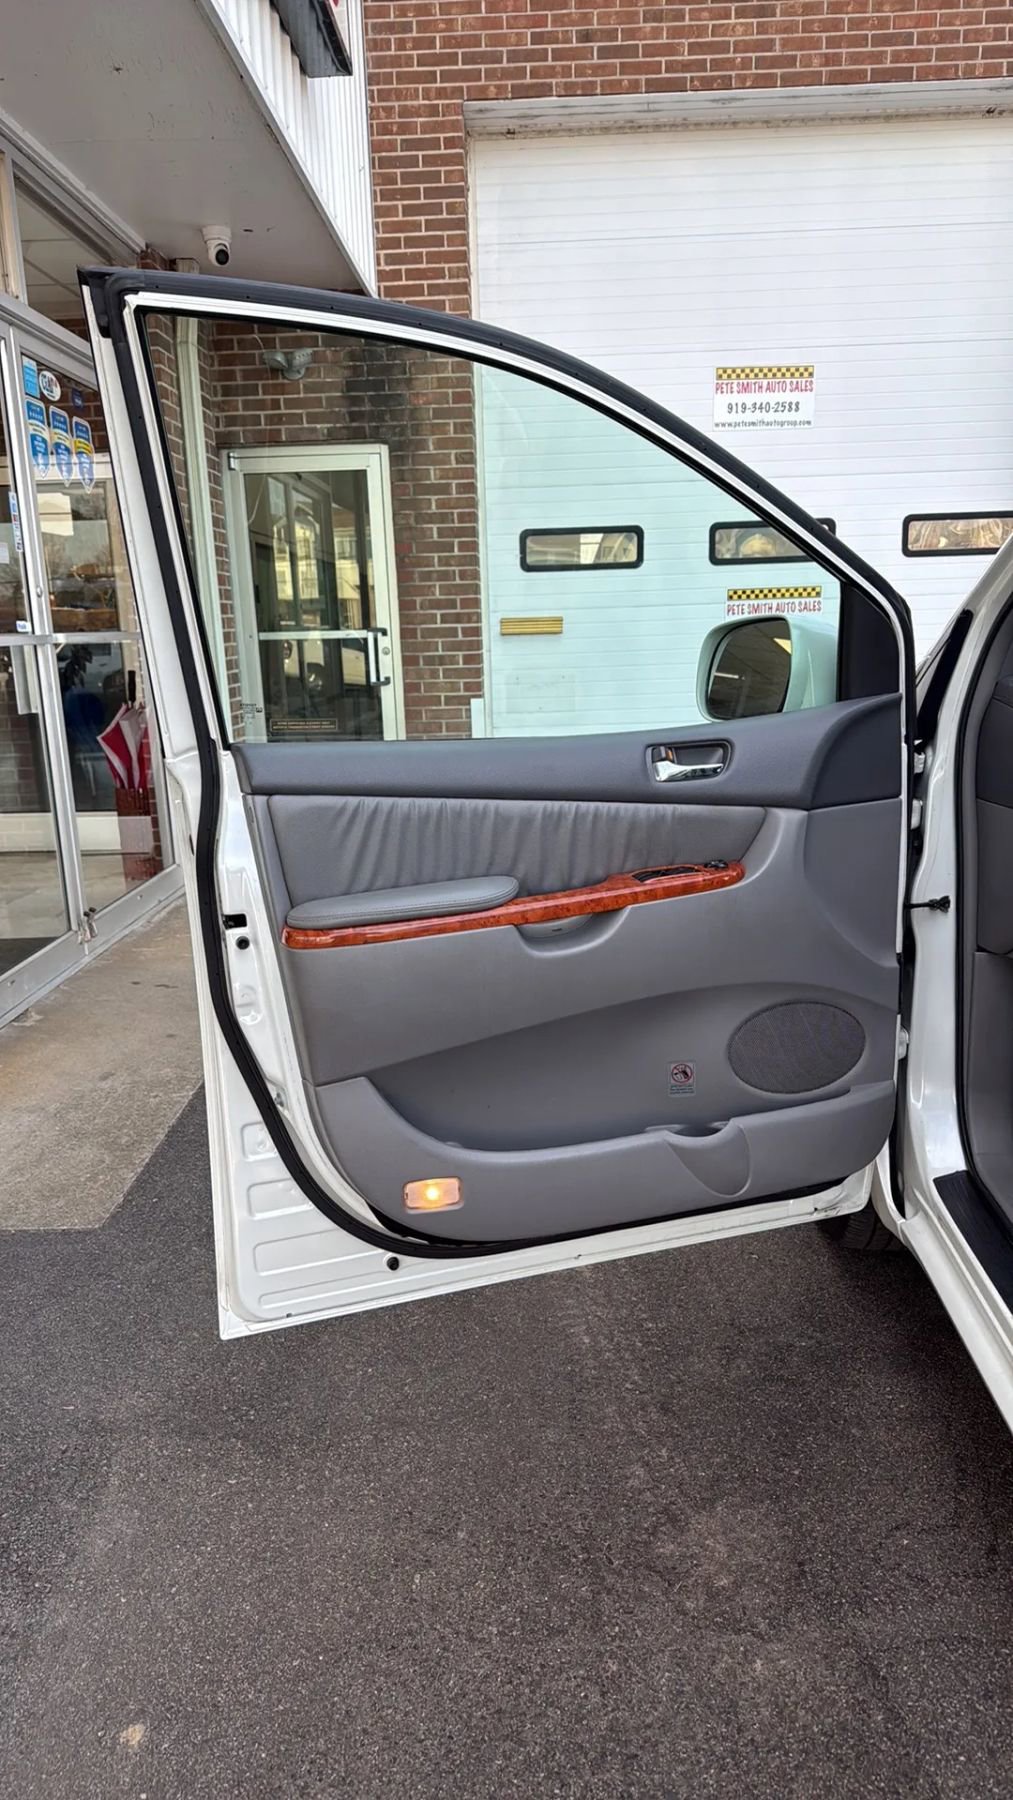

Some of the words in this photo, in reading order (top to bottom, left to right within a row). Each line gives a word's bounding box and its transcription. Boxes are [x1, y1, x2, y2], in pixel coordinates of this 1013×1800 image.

[715, 381, 734, 394] PETE
[736, 381, 763, 394] SMITH
[765, 380, 787, 393] AUTO
[789, 379, 814, 392] SALES
[727, 401, 800, 414] 919-340-2588
[714, 418, 812, 428] www.petesmithautogroup.com
[727, 603, 745, 616] PETE
[747, 602, 773, 615] SMITH
[775, 601, 796, 613] AUTO
[797, 600, 822, 612] SALES
